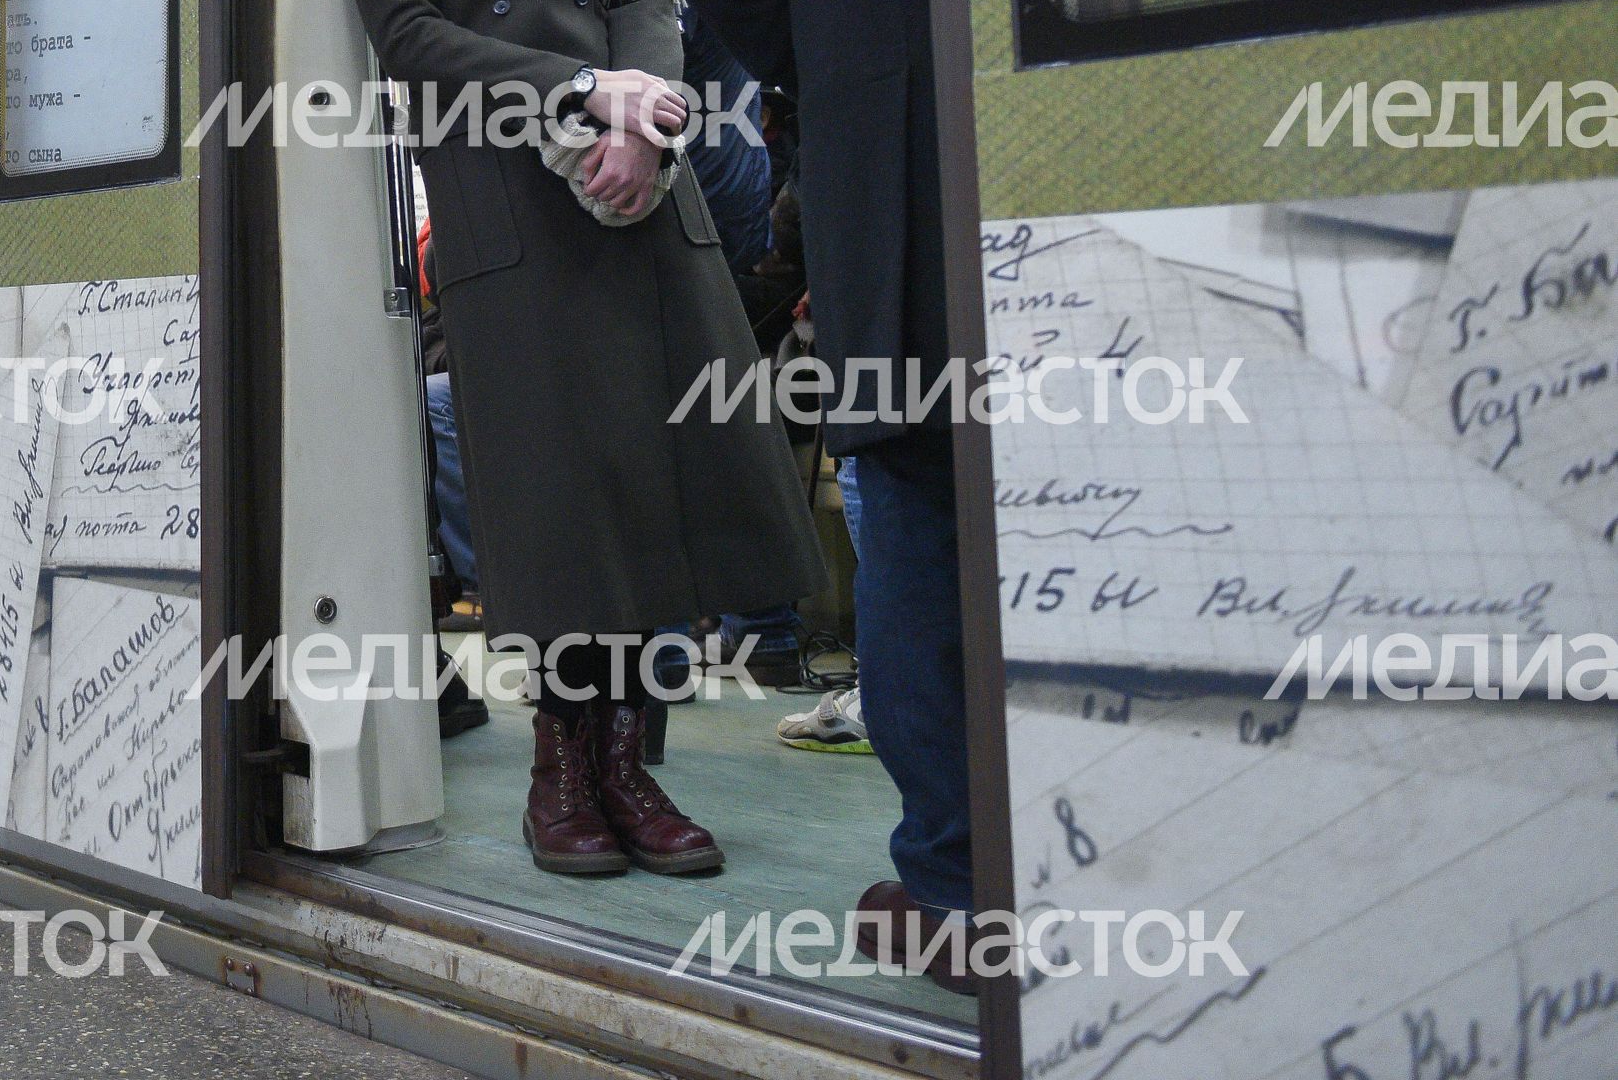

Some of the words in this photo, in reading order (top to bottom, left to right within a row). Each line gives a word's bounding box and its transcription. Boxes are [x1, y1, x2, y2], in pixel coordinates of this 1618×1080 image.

[31, 34, 74, 58] брата
[28, 91, 64, 111] мужа
[28, 146, 62, 163] сына
